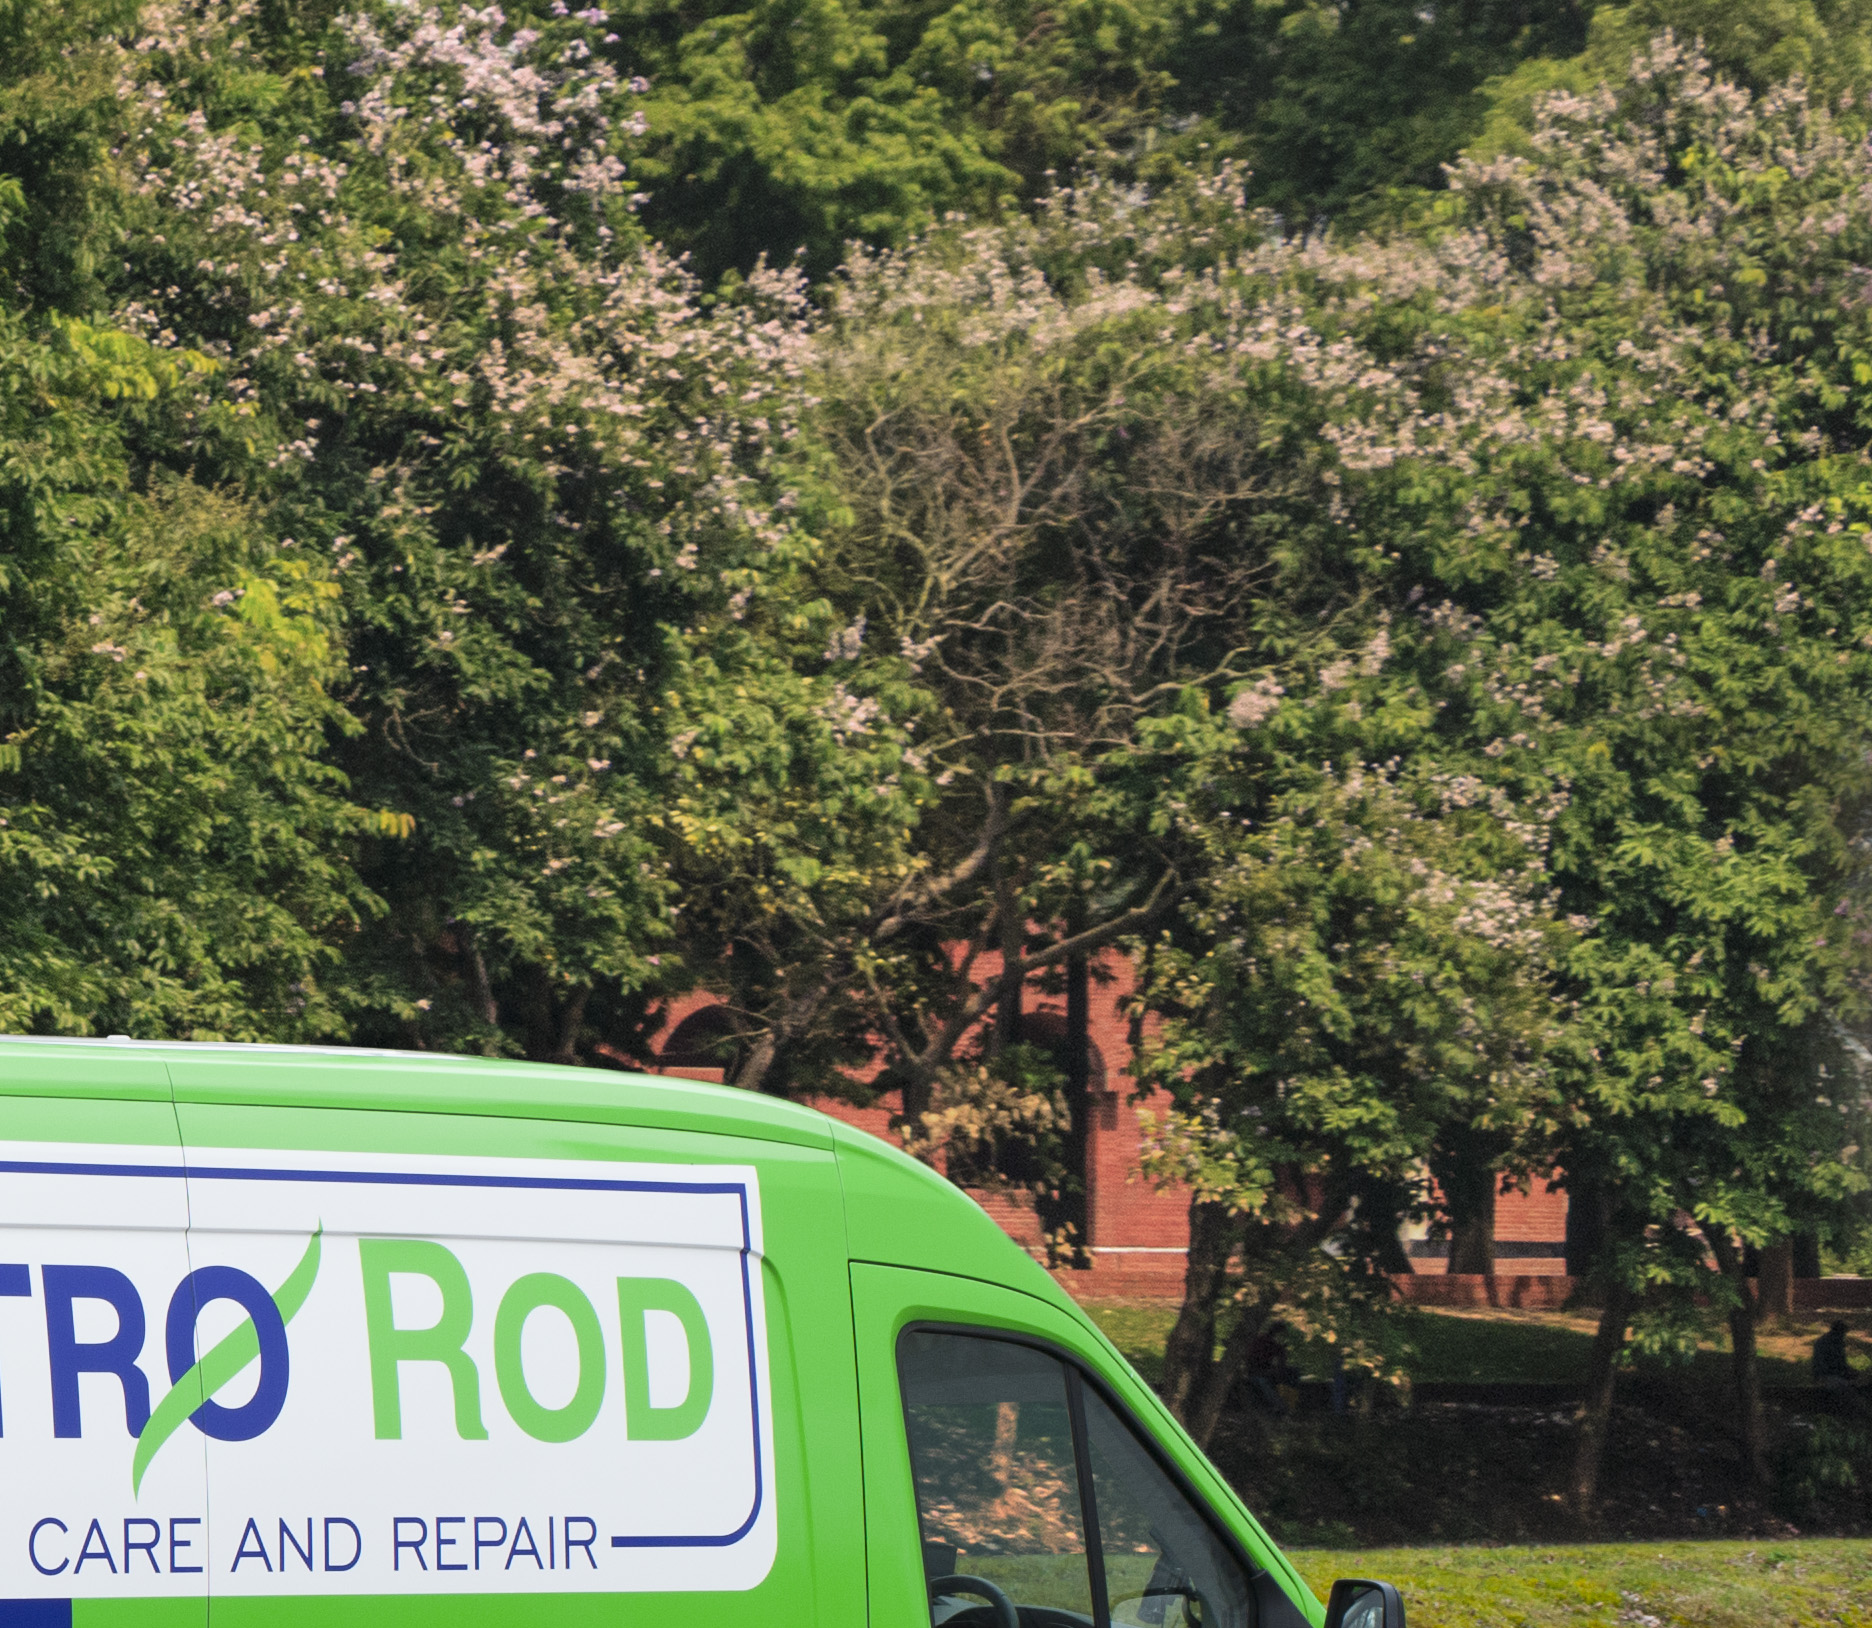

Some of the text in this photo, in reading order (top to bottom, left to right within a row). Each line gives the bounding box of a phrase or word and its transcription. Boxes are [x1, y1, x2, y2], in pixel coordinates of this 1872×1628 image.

[358, 1235, 716, 1443] ROD
[28, 1517, 203, 1576] CARE
[231, 1517, 362, 1573] AND
[392, 1516, 599, 1570] REPAIR
